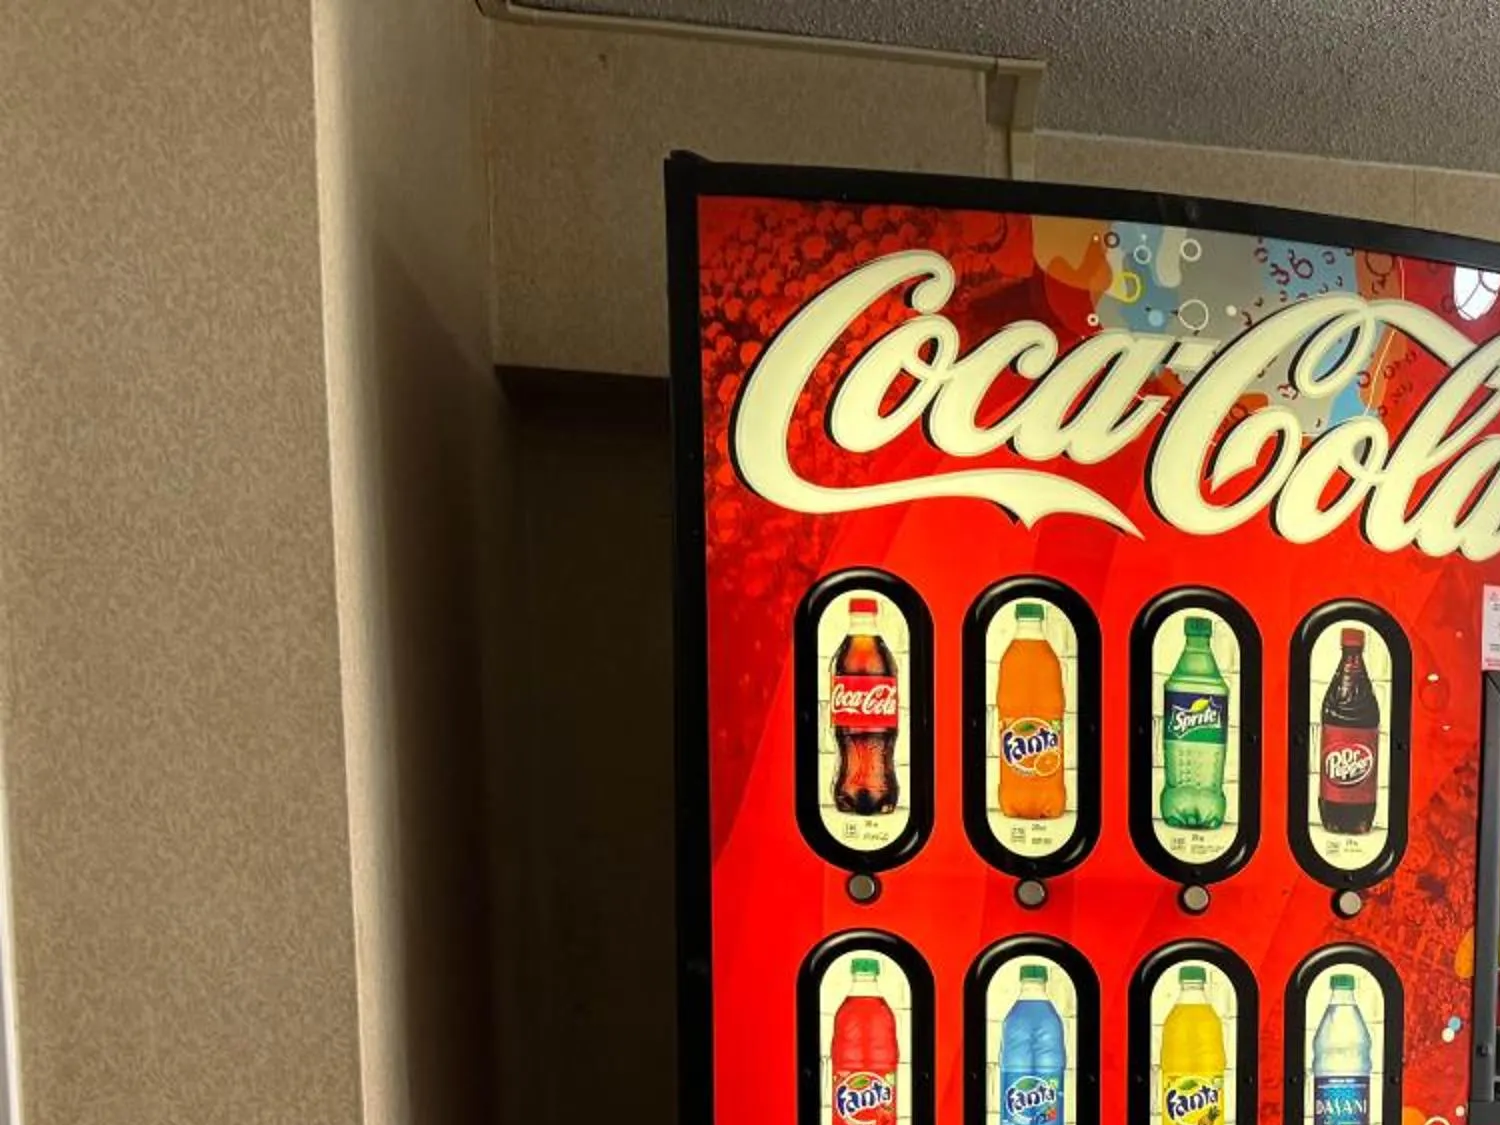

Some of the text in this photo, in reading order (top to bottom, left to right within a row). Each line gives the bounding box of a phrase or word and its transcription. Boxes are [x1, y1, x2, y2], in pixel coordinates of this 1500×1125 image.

[831, 683, 897, 714] Coca-Cola
[1173, 708, 1219, 732] Sprite
[1326, 751, 1373, 781] Pepper
[1341, 746, 1361, 763] Dr
